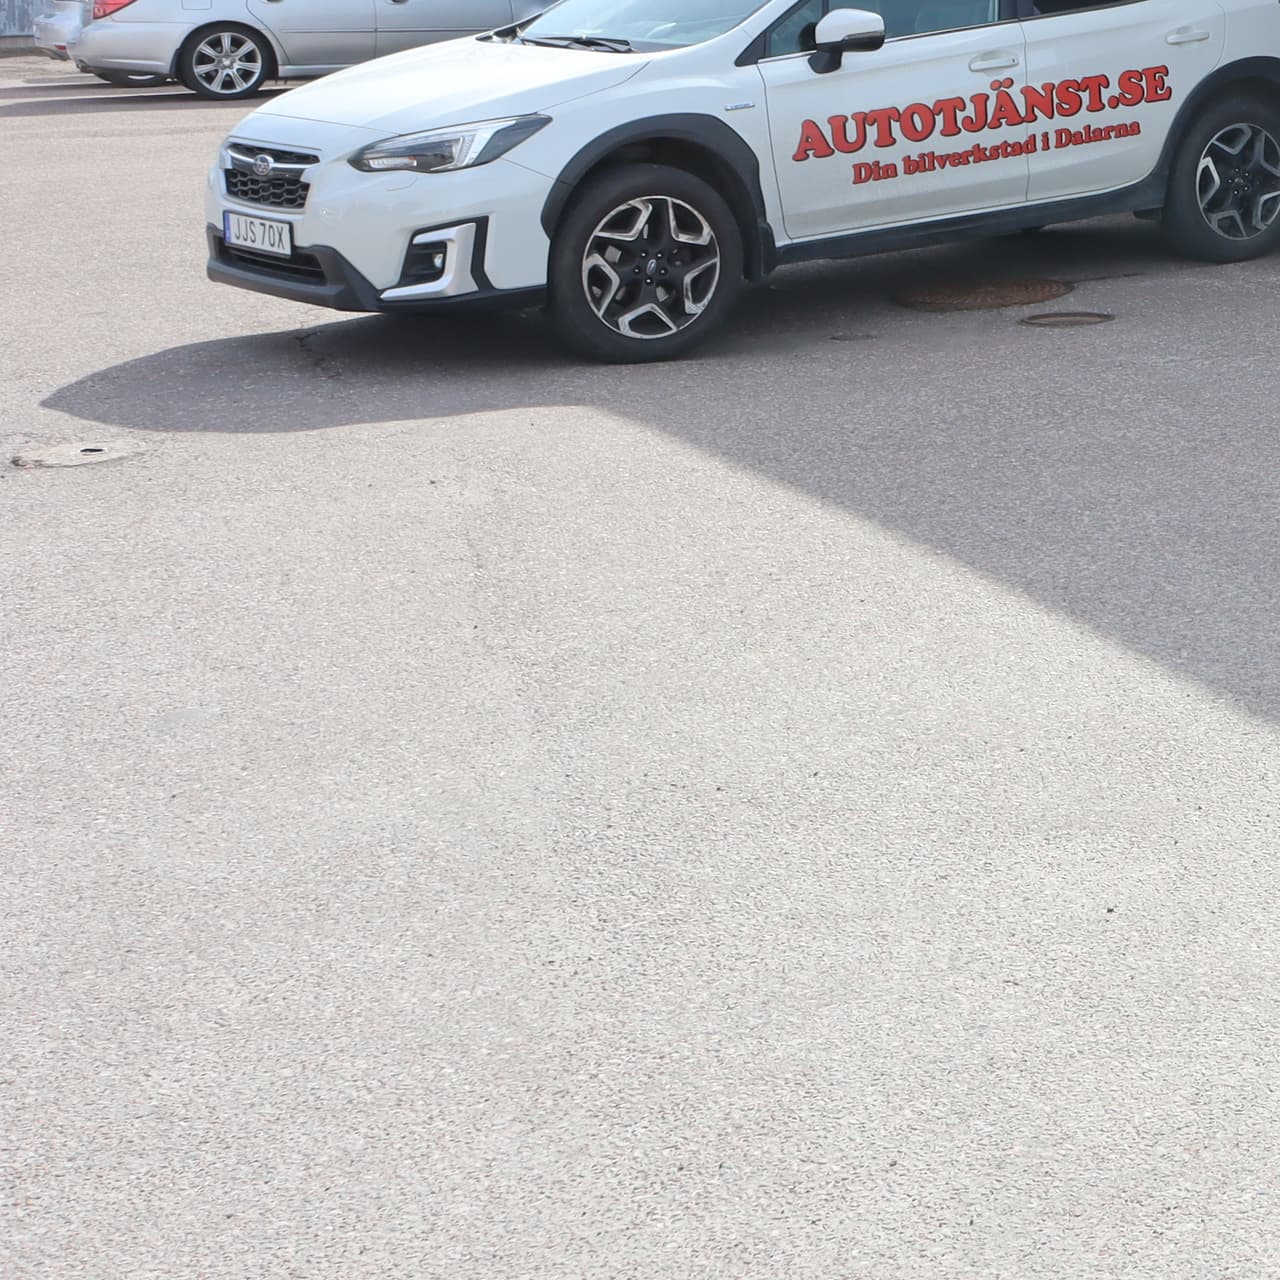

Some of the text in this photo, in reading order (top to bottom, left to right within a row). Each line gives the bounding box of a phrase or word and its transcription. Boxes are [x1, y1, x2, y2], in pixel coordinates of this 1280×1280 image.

[792, 65, 1172, 161] AUTOTJÄNST.SE
[852, 121, 1141, 184] Din bilverkstad i Dalarna
[234, 217, 286, 249] JJS 70X
